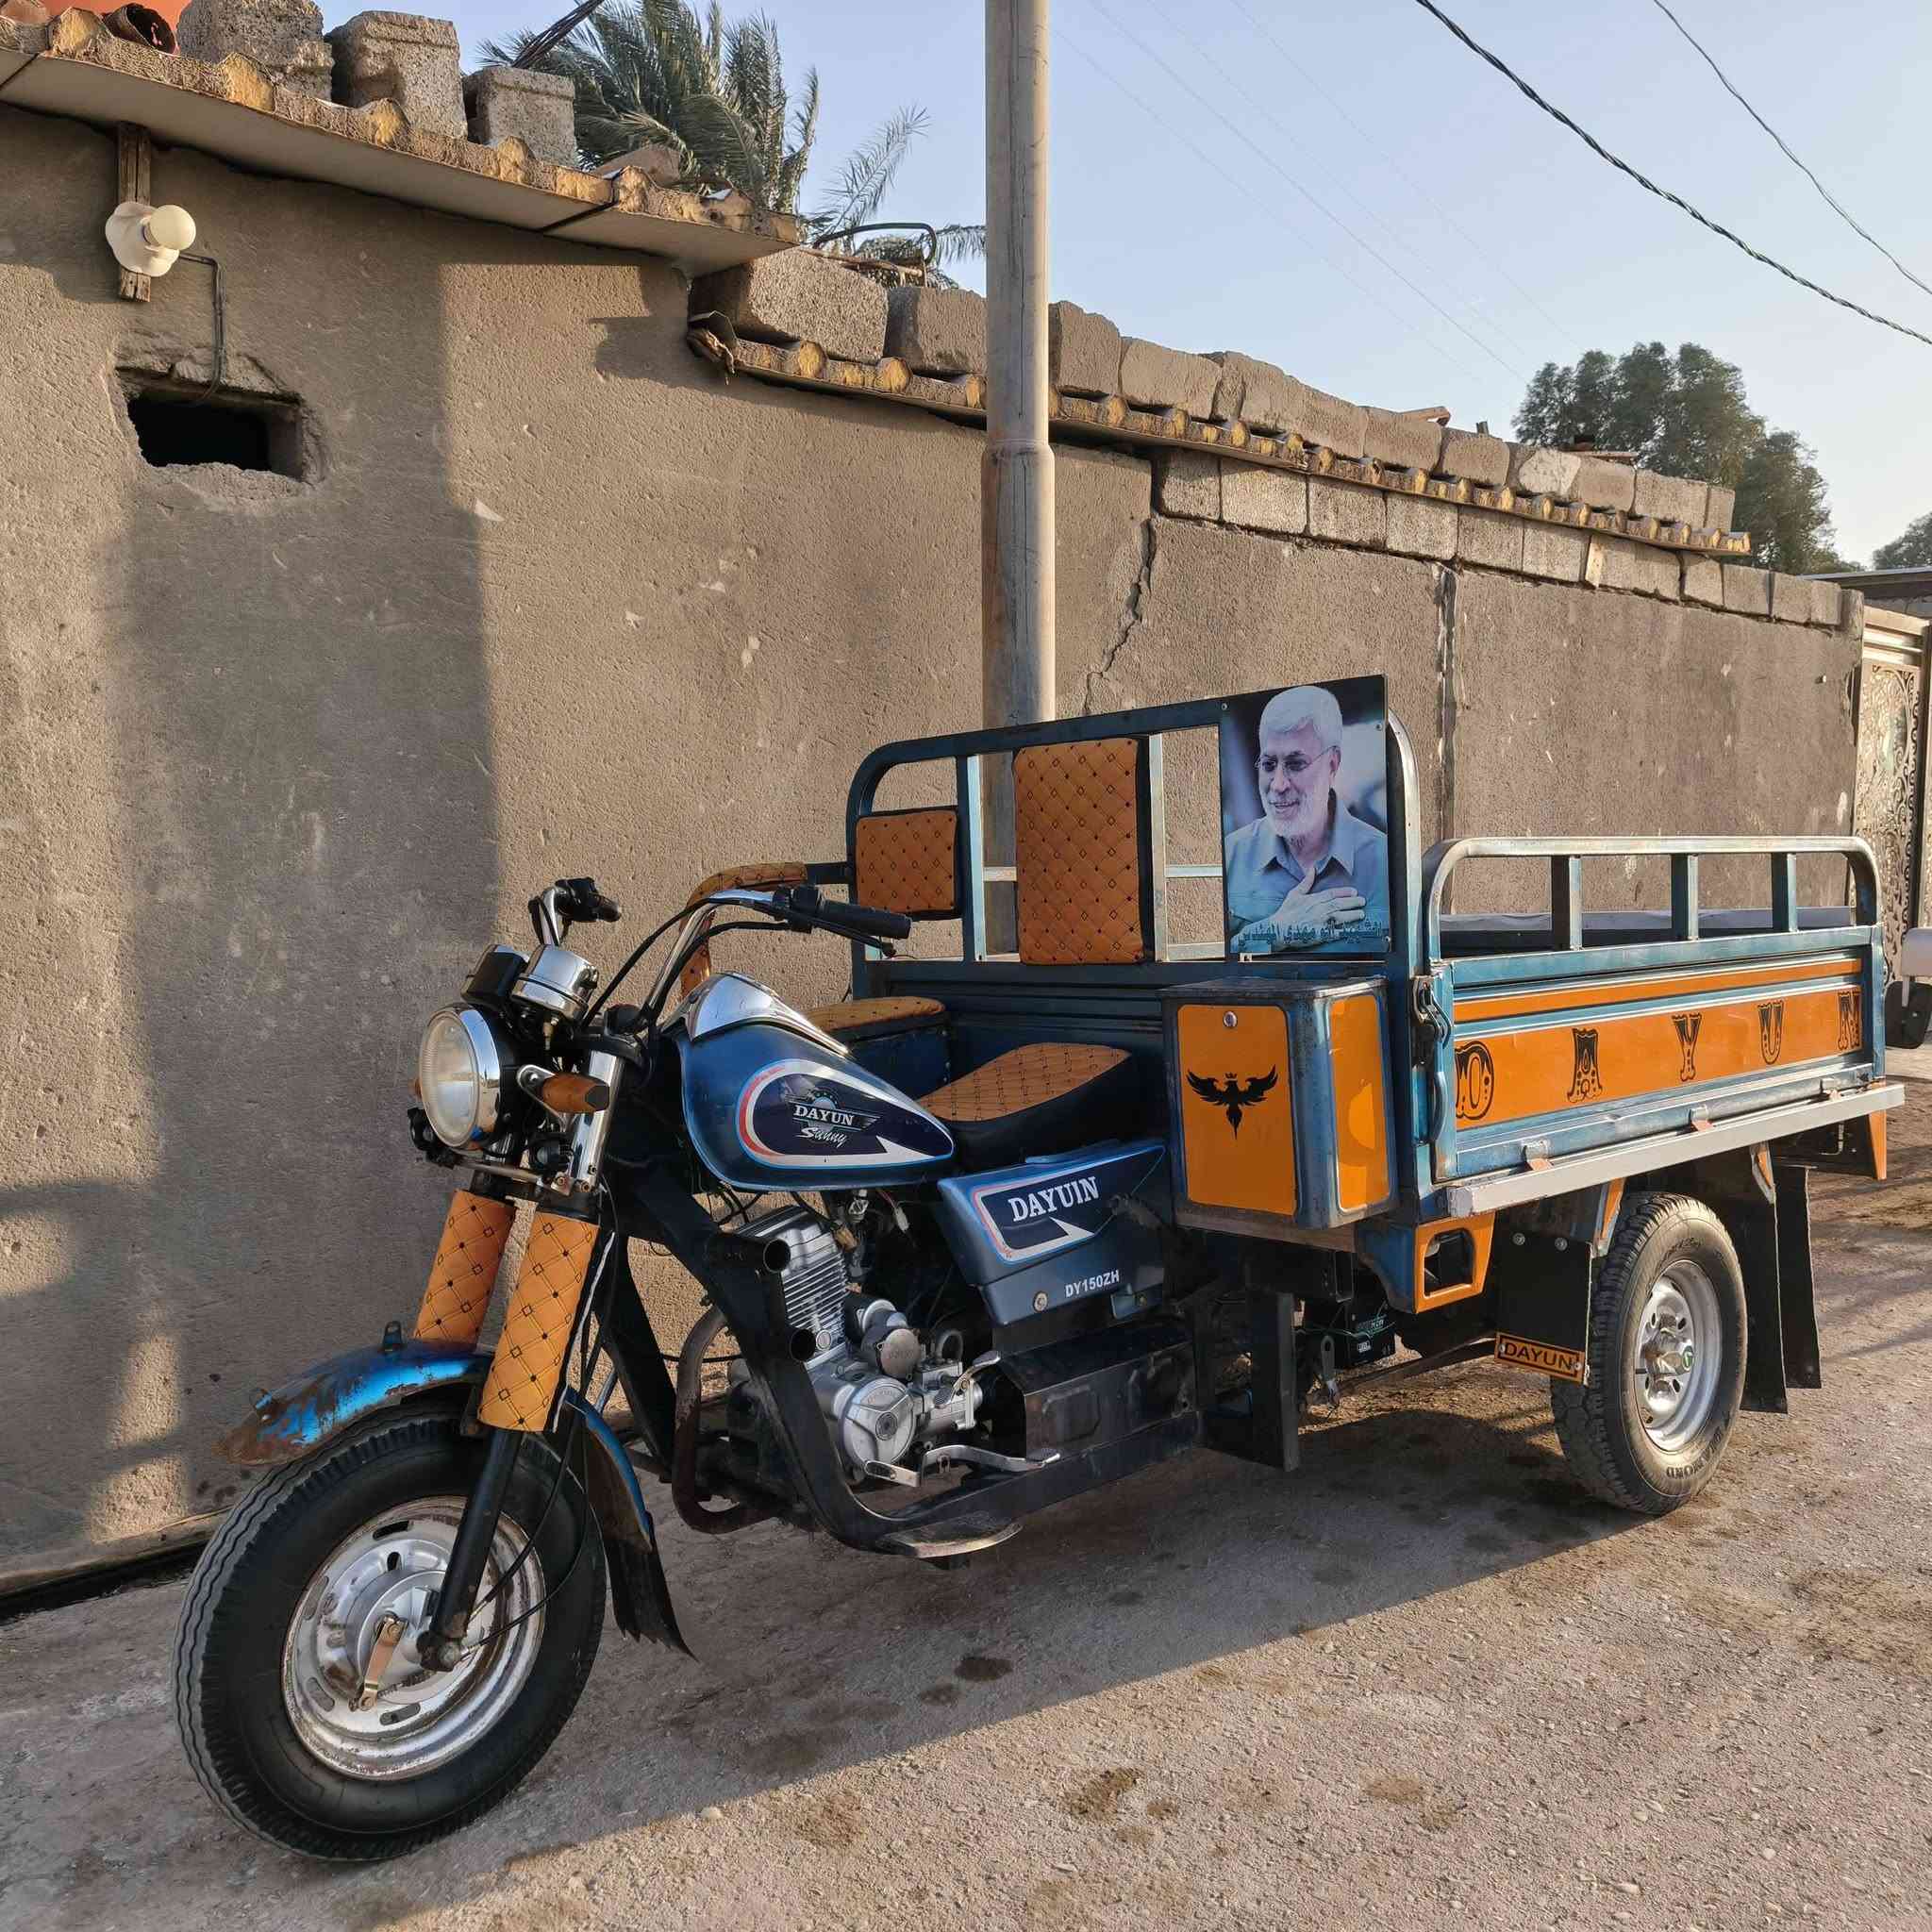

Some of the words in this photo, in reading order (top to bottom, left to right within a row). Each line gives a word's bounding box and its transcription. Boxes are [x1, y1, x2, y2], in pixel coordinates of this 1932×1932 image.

[792, 1104, 855, 1126] DAYUN
[797, 1126, 848, 1148] Sunny
[1008, 1176, 1101, 1222] DAYUIN
[1065, 1270, 1120, 1298] DY150ZH
[1505, 1342, 1572, 1371] DAYUN
